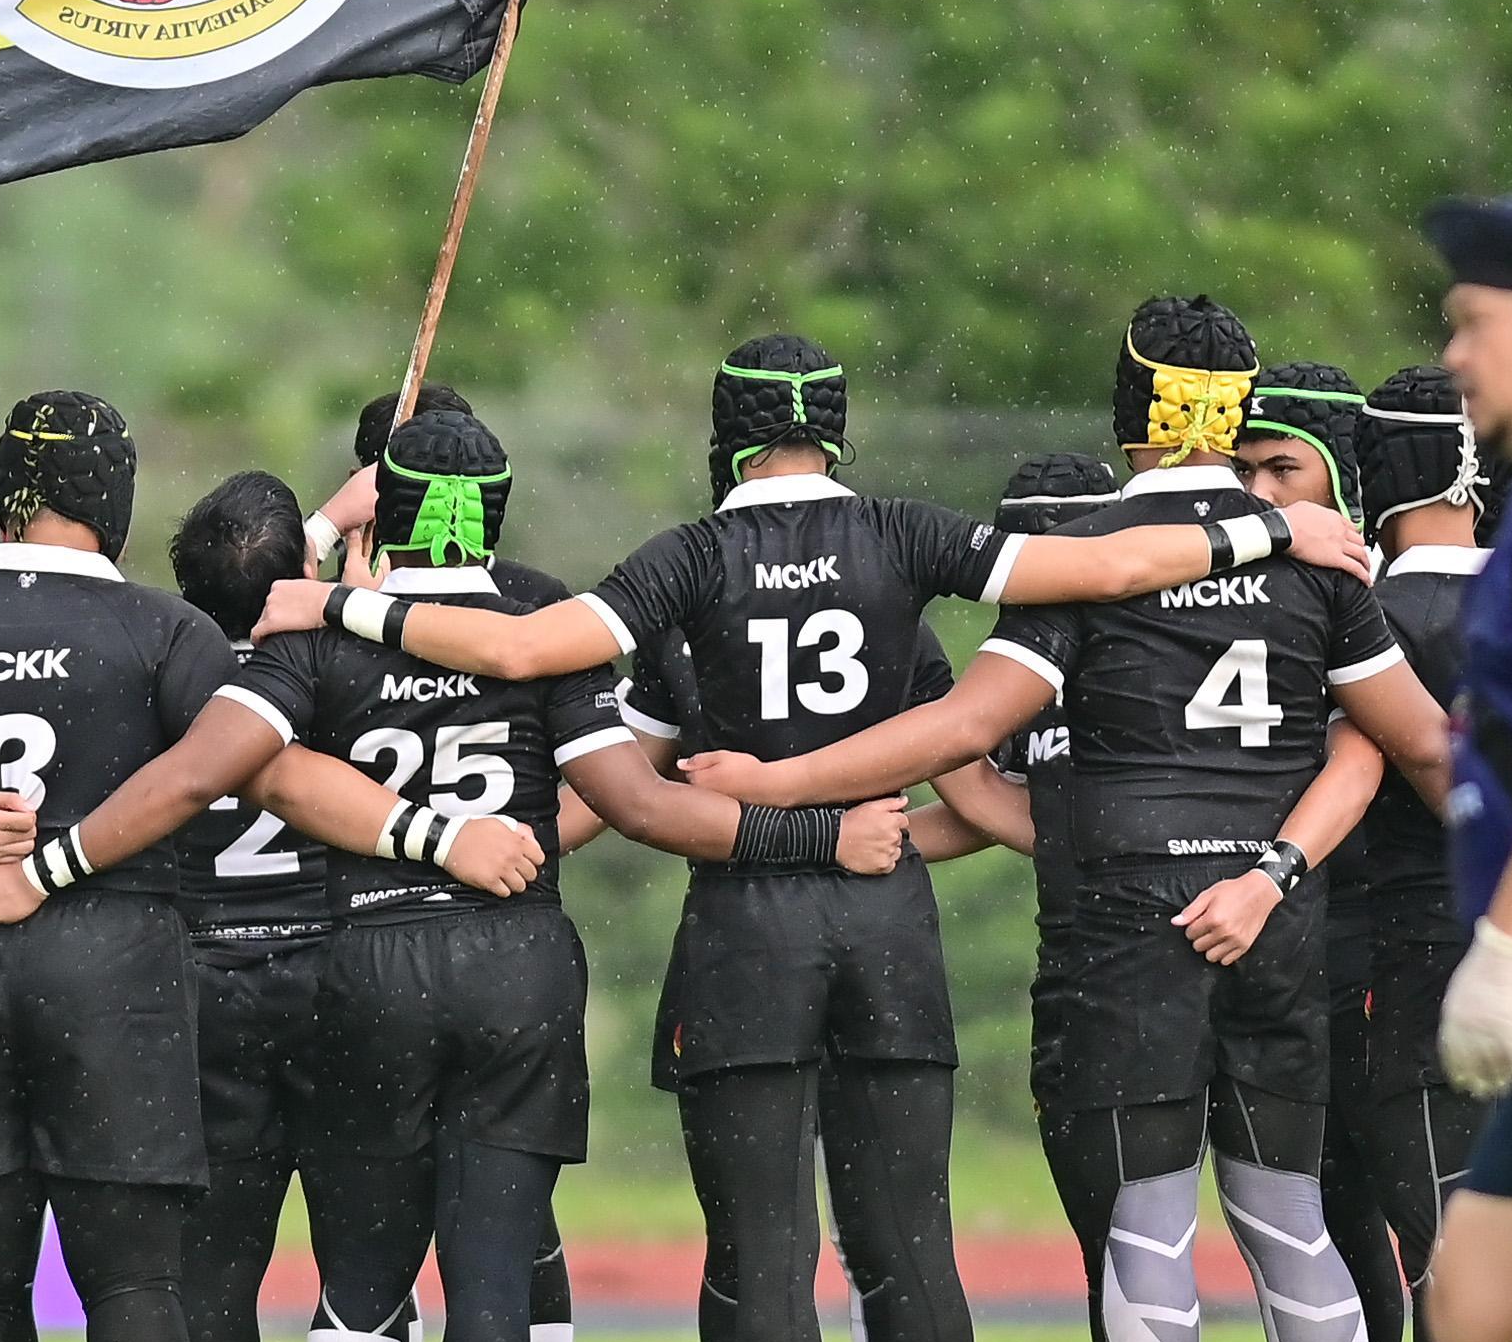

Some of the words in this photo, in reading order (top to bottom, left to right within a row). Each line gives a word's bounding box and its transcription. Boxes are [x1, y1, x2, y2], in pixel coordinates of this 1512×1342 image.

[754, 555, 841, 591] MCKK
[1159, 574, 1271, 610] MCKK
[747, 609, 870, 721] 13
[380, 672, 481, 702] MCKK
[1185, 638, 1284, 749] 4
[349, 721, 517, 816] 25
[1167, 839, 1238, 856] SMART
